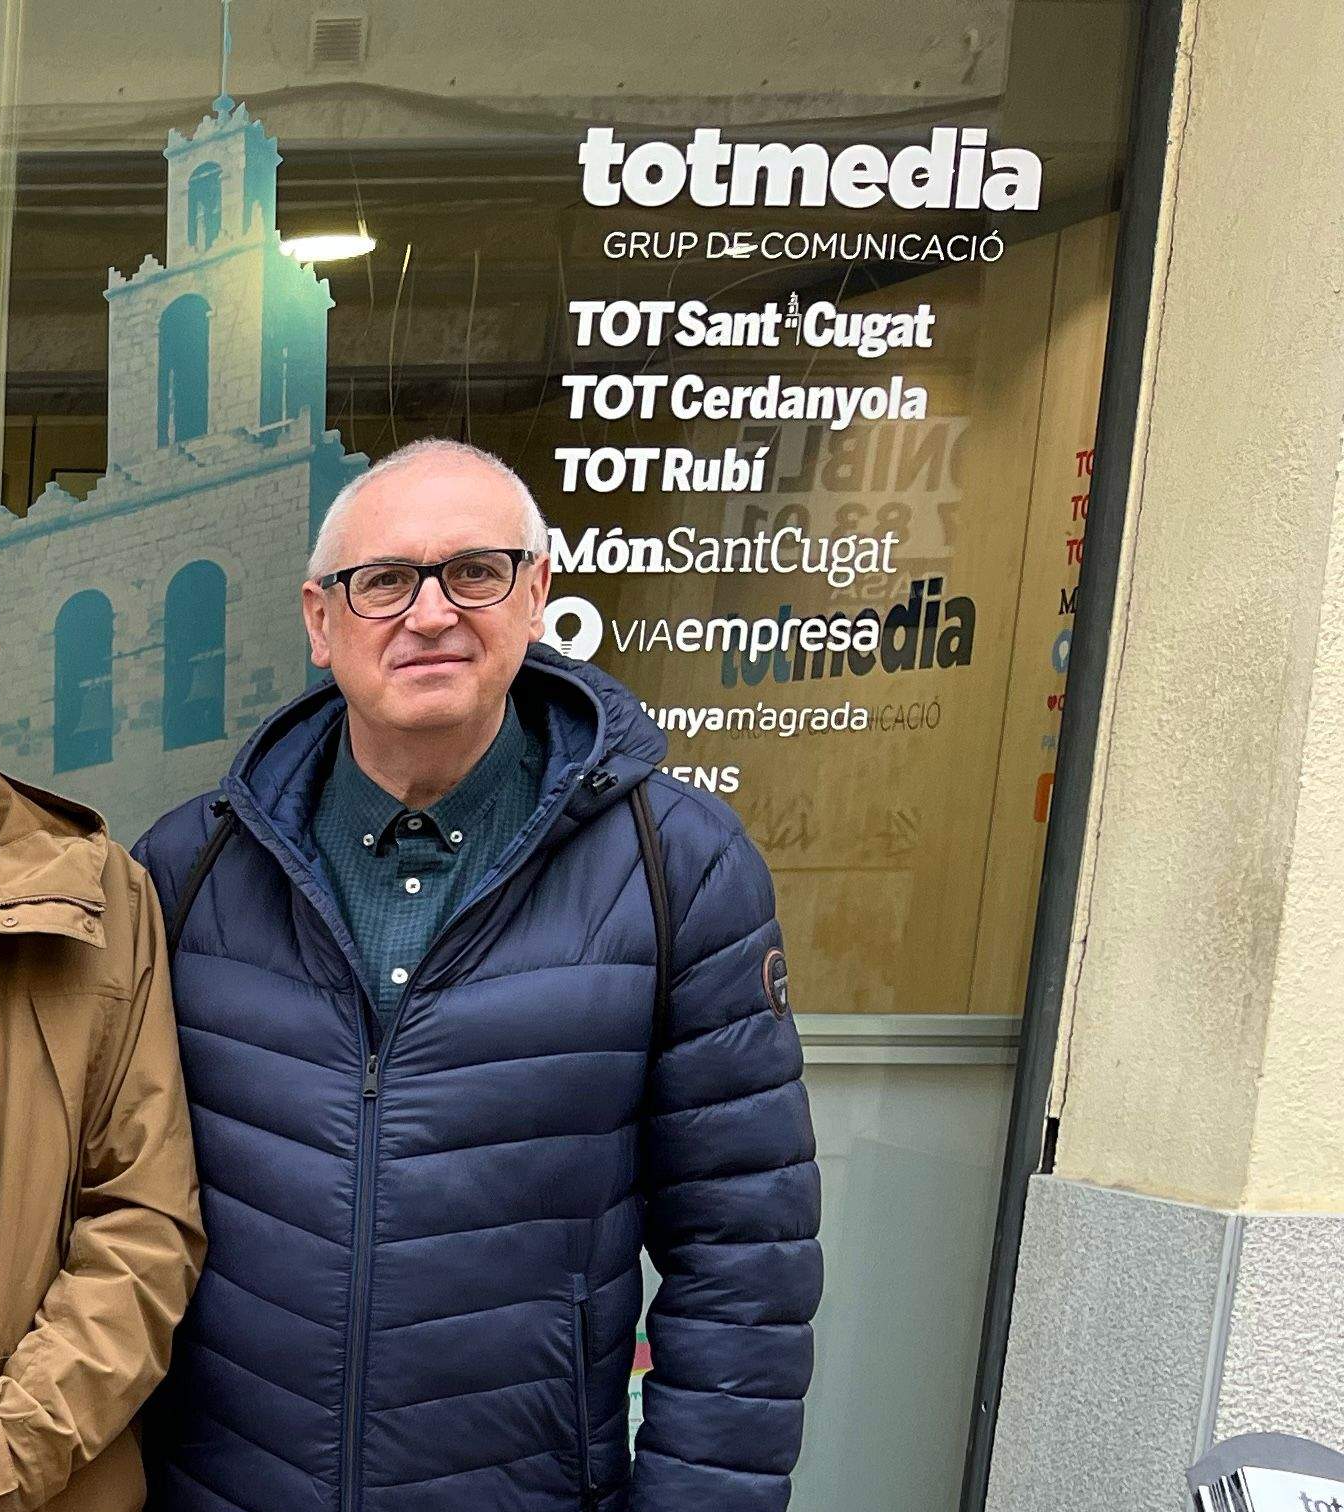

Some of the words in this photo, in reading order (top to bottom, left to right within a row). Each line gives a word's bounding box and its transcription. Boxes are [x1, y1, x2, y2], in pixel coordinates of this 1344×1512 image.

[578, 126, 1042, 211] totmedia
[603, 231, 699, 259] GRUP
[706, 232, 754, 260] DE
[760, 228, 1005, 262] COMUNICACIÓ
[569, 301, 676, 347] TOT
[674, 301, 782, 347] Sant
[803, 301, 937, 358] Cugat
[562, 374, 668, 420] TOT
[670, 374, 928, 431] Cerdanyola
[554, 447, 660, 493] TOT
[661, 445, 771, 493] Rubí
[547, 526, 900, 589] MónSantCugat
[611, 617, 880, 663] VIAempresa
[640, 701, 869, 738] unyam'agrada
